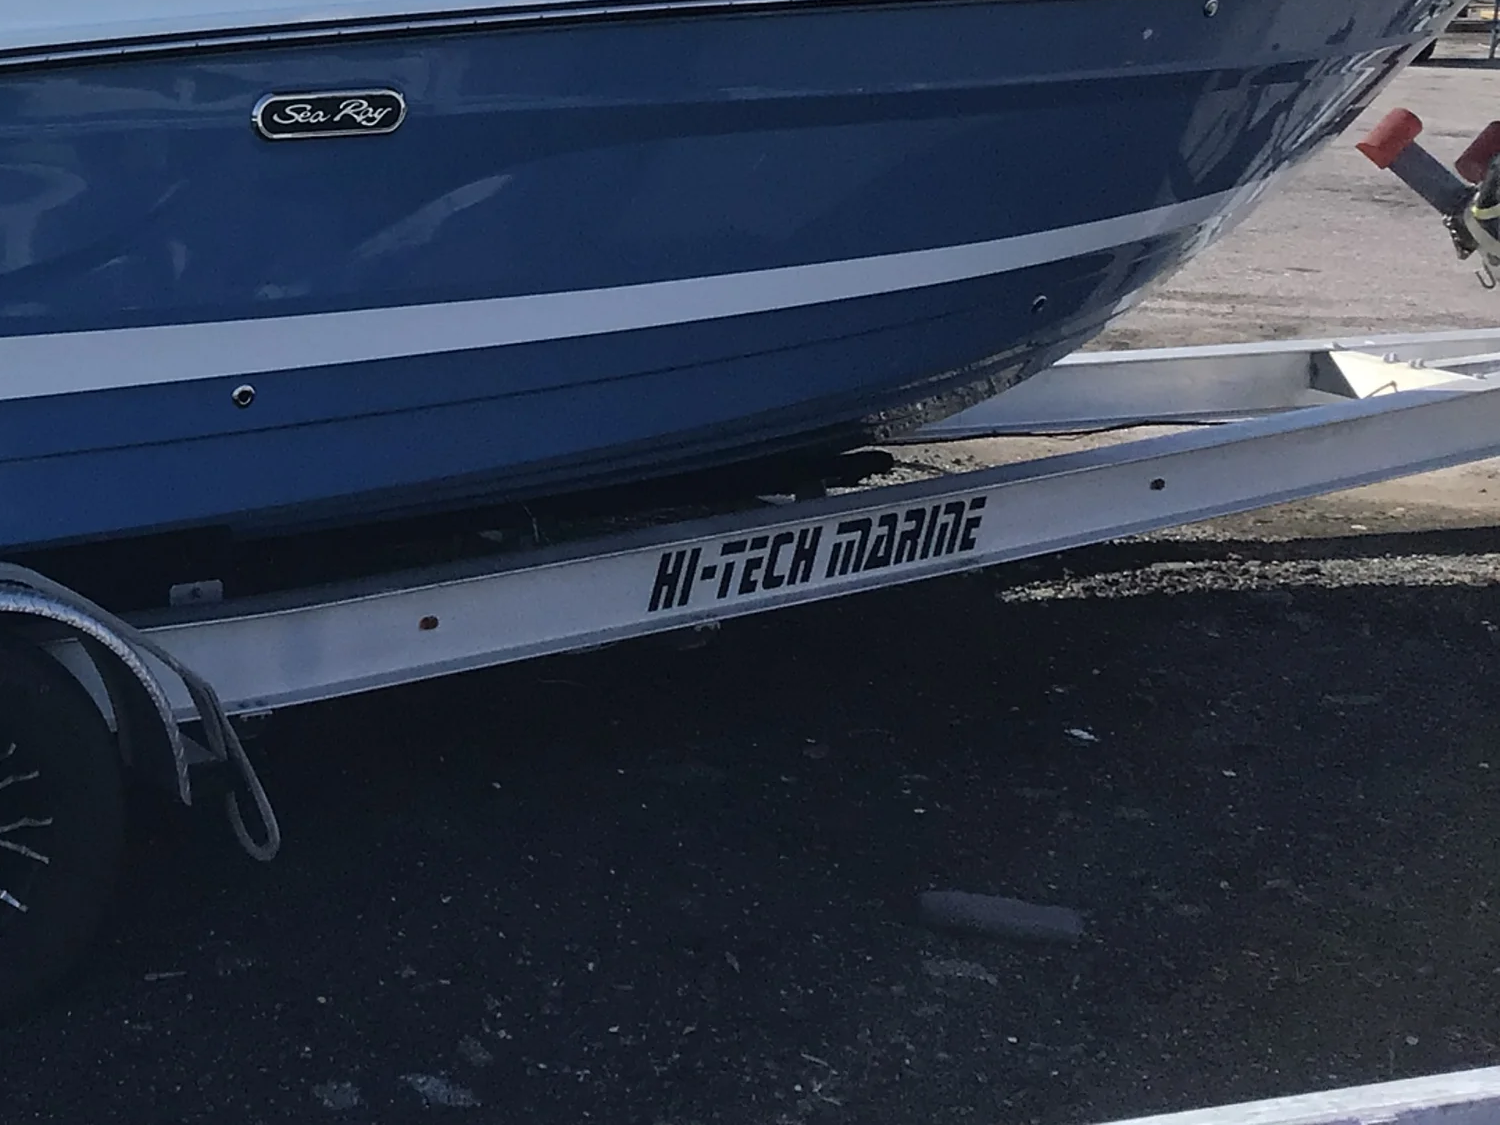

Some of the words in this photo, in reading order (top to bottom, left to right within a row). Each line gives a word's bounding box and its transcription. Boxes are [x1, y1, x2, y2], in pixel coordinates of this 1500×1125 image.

[272, 104, 331, 124] Sea
[333, 99, 392, 126] Ray
[648, 526, 823, 613] HI-TECH
[825, 496, 987, 578] MARINE
